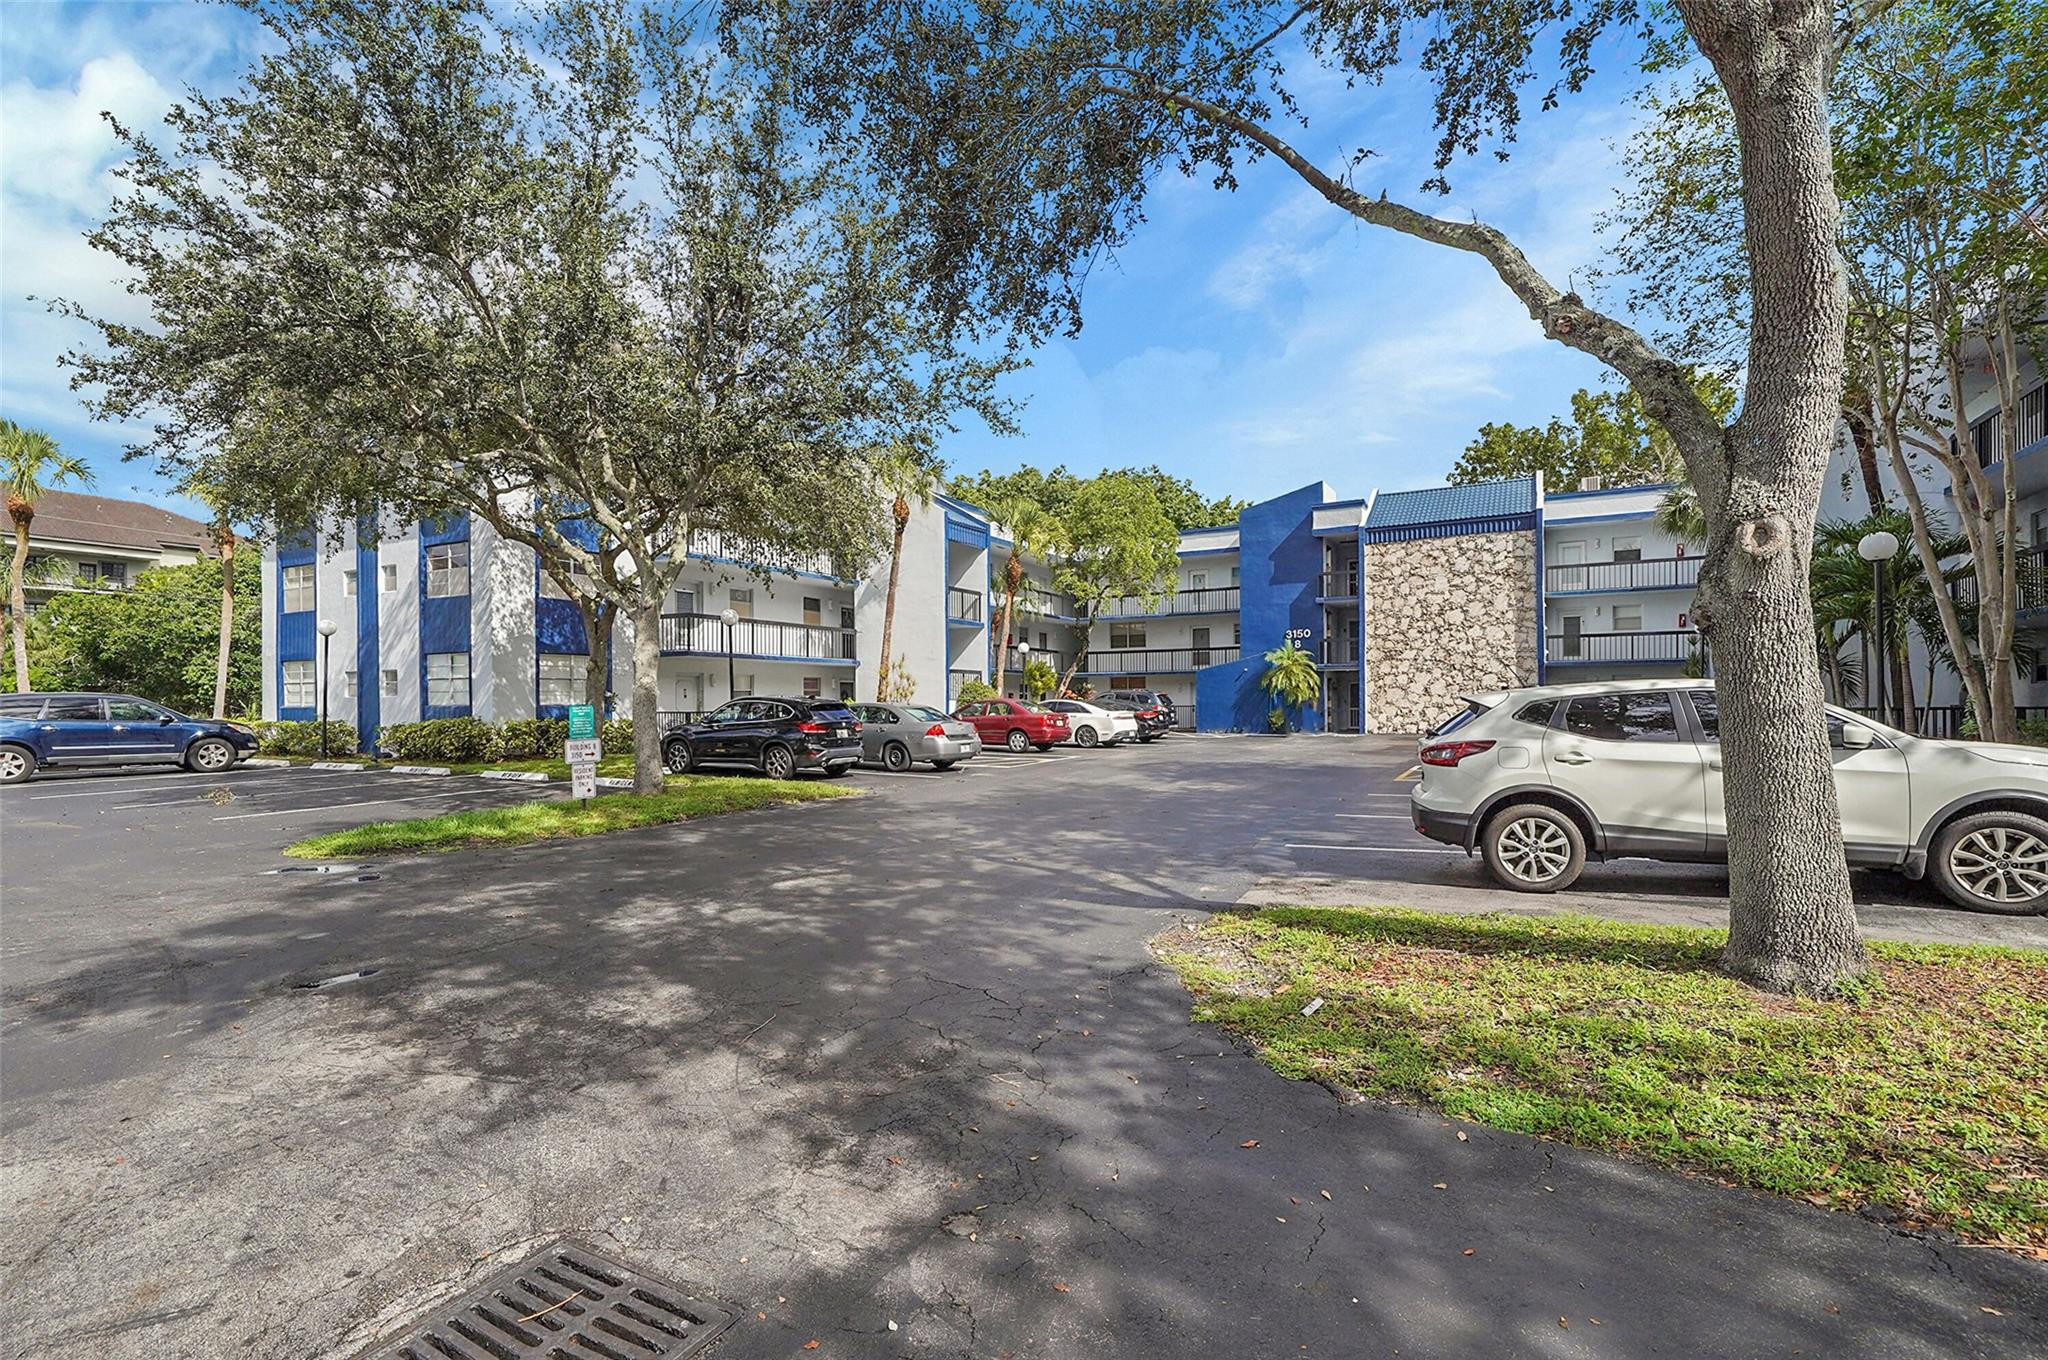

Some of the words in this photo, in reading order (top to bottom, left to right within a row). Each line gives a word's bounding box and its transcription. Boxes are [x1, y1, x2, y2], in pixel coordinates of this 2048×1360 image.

[1285, 628, 1311, 639] 3150
[1294, 639, 1302, 649] 8
[569, 743, 592, 751] BUILDING
